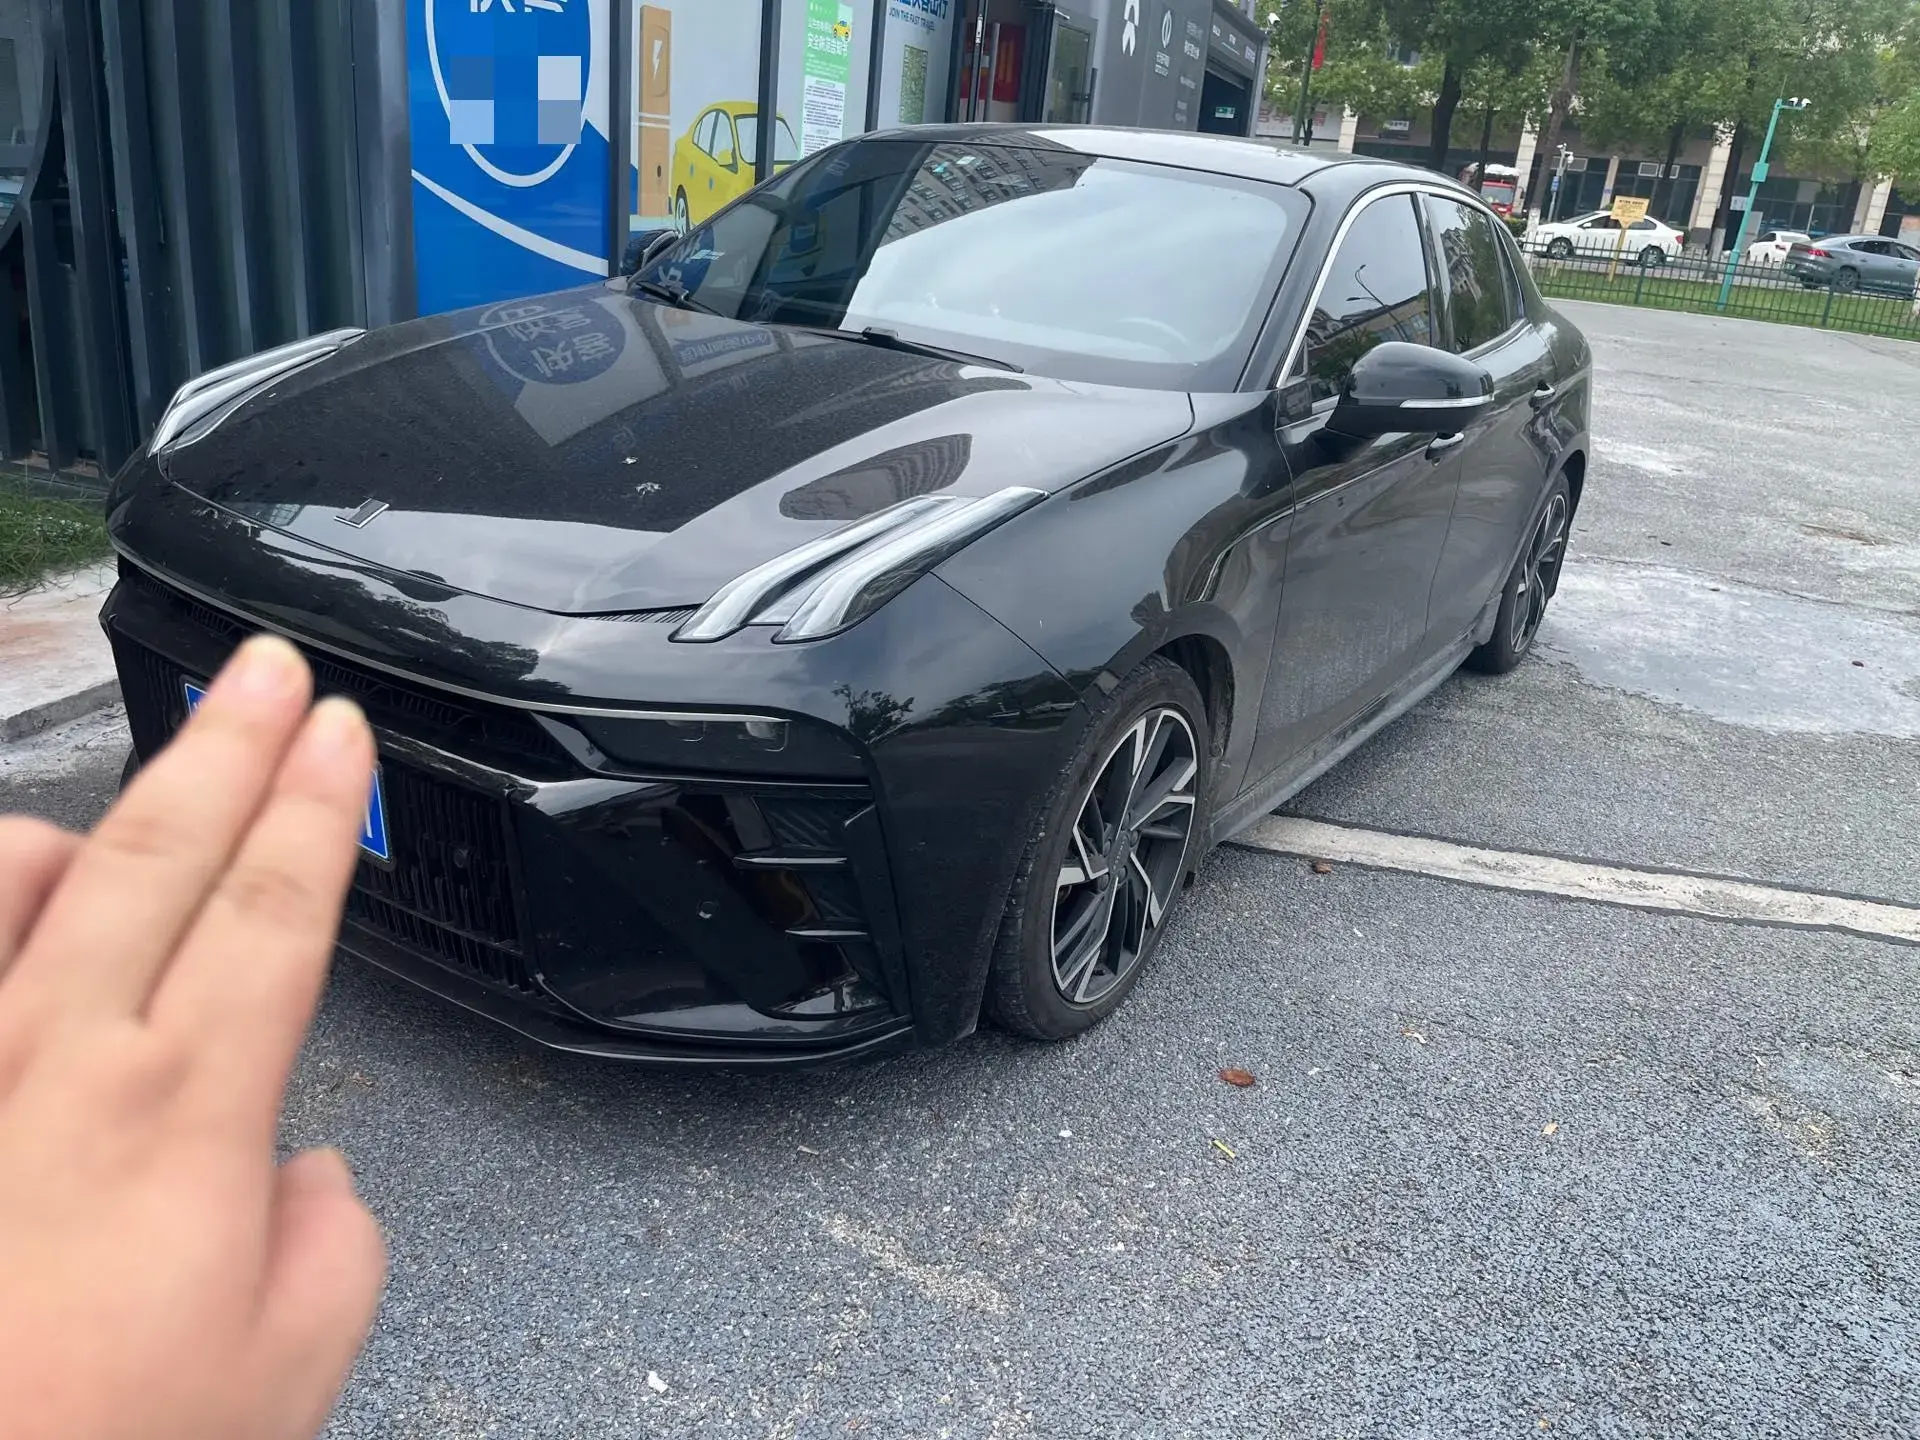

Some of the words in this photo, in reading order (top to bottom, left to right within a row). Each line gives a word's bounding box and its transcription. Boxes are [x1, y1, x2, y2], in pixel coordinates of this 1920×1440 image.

[889, 7, 900, 19] JOIN
[900, 9, 910, 23] THE
[909, 13, 921, 26] FAST
